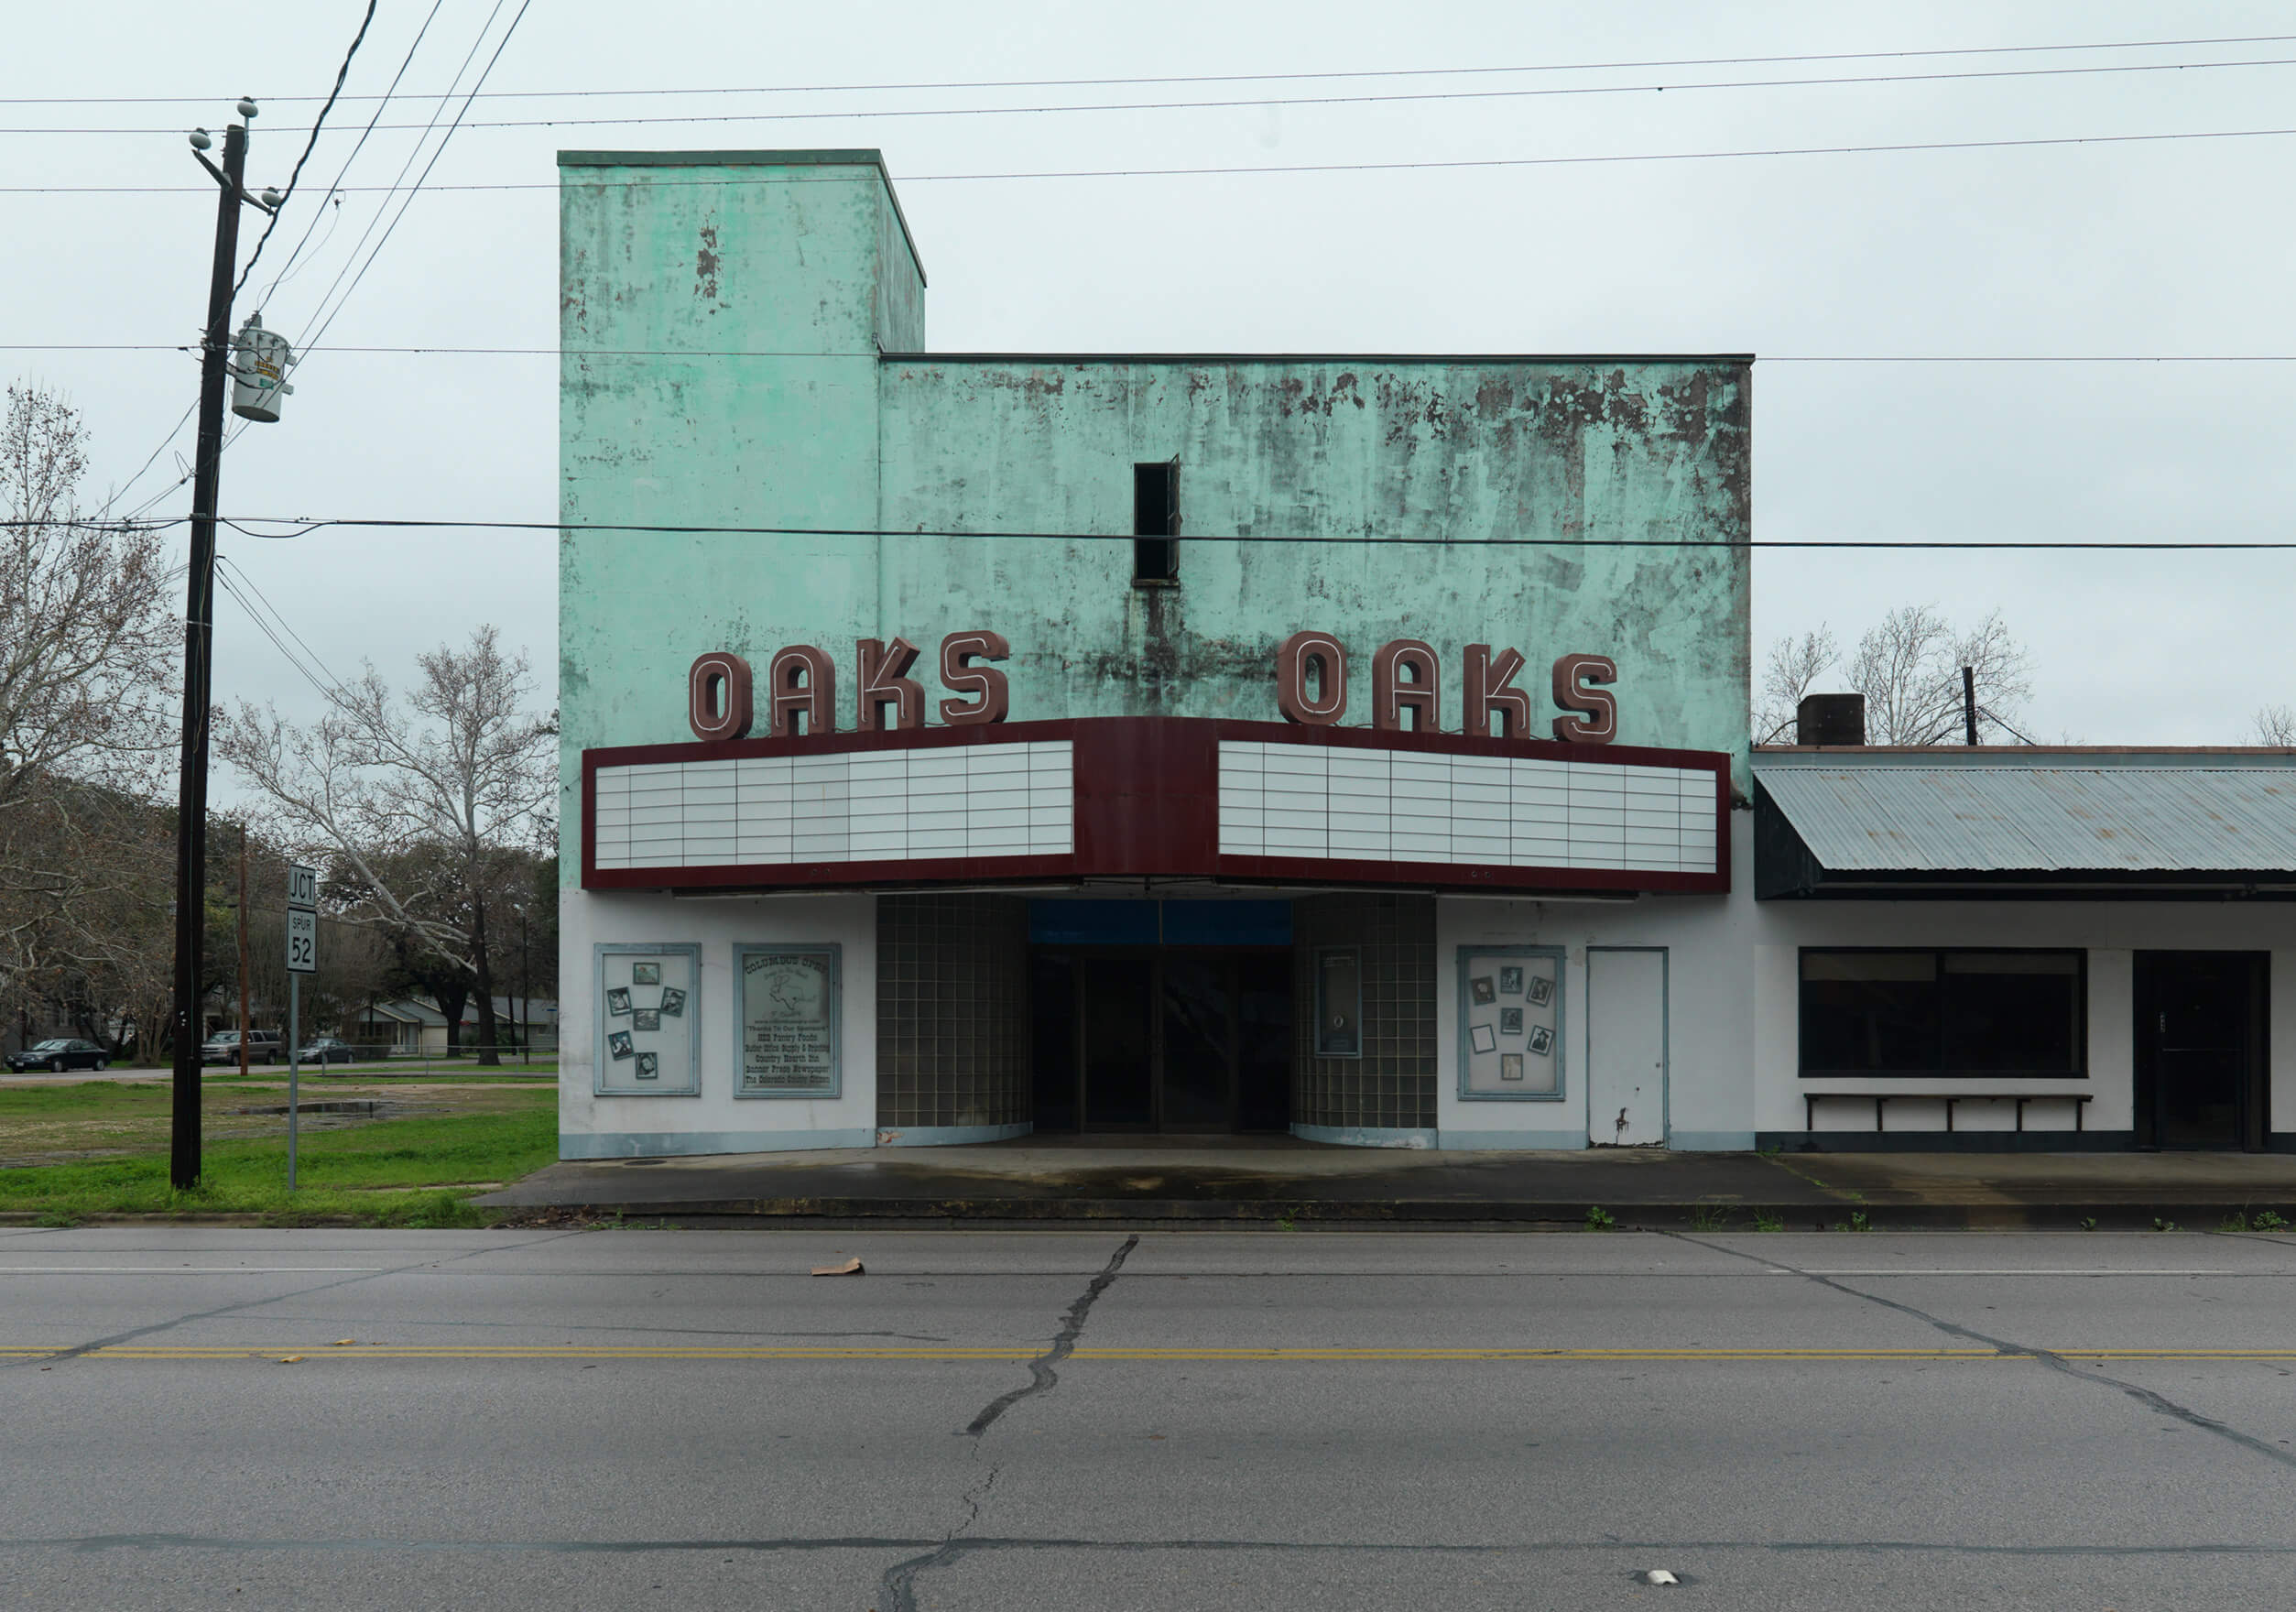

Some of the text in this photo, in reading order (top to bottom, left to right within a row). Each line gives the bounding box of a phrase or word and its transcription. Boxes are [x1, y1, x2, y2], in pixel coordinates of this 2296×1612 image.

[689, 630, 1010, 742] OAKS
[1277, 630, 1617, 744] OAKS
[290, 872, 313, 900] JCT
[292, 916, 311, 931] SPUR
[292, 936, 311, 964] 52
[745, 955, 799, 975] COLUMBUS
[773, 1033, 796, 1043] Pantry
[798, 1033, 818, 1042] Foods
[756, 1054, 781, 1064] Country
[793, 1065, 831, 1075] Newspaper
[746, 1075, 756, 1084] The
